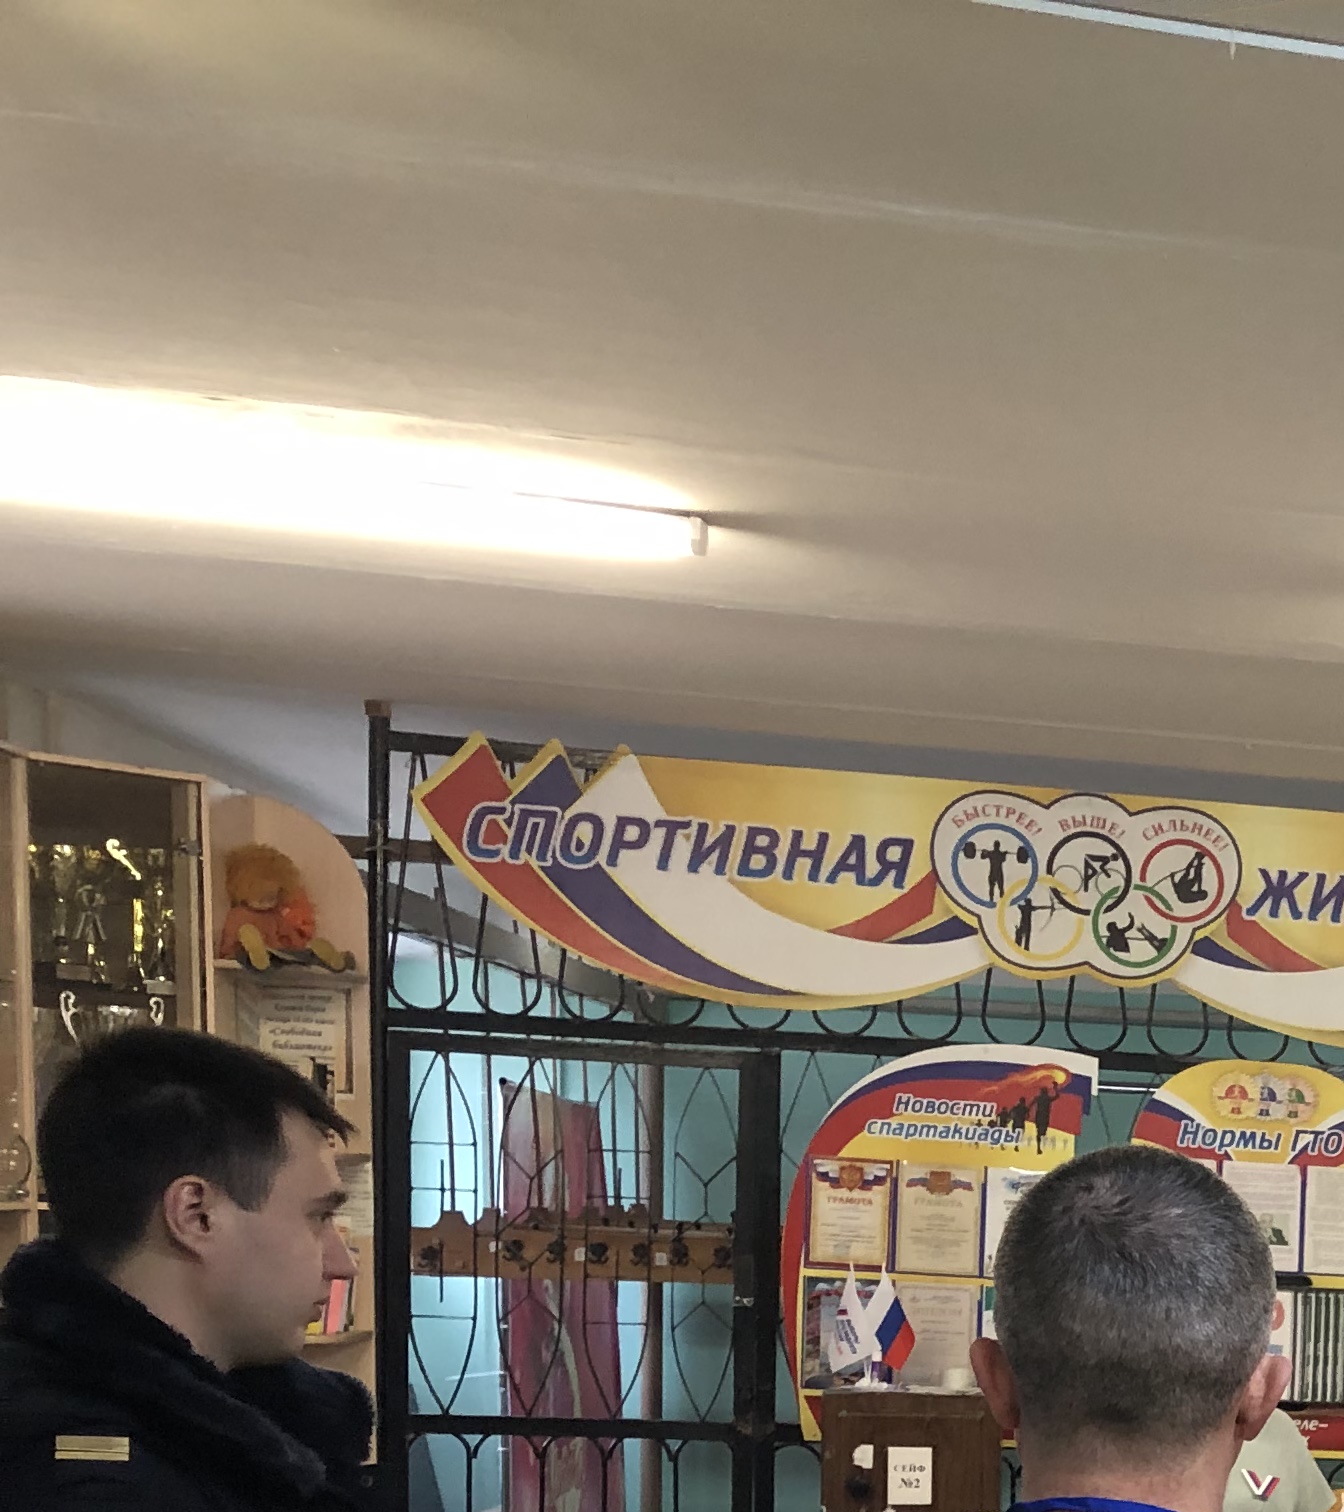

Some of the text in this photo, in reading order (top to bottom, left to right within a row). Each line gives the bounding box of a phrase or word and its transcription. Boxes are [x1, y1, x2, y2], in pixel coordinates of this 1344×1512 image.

[952, 804, 1229, 852] БЫСТРЕЕ! ВЫШЕ! СИЛЬНЕЕ!
[466, 804, 914, 890] СПОРТИВНАЯ
[894, 1095, 995, 1118] Новости
[866, 1119, 1021, 1145] спартакиады
[1179, 1122, 1344, 1154] Нормы ГТО
[898, 1477, 921, 1489] №2
